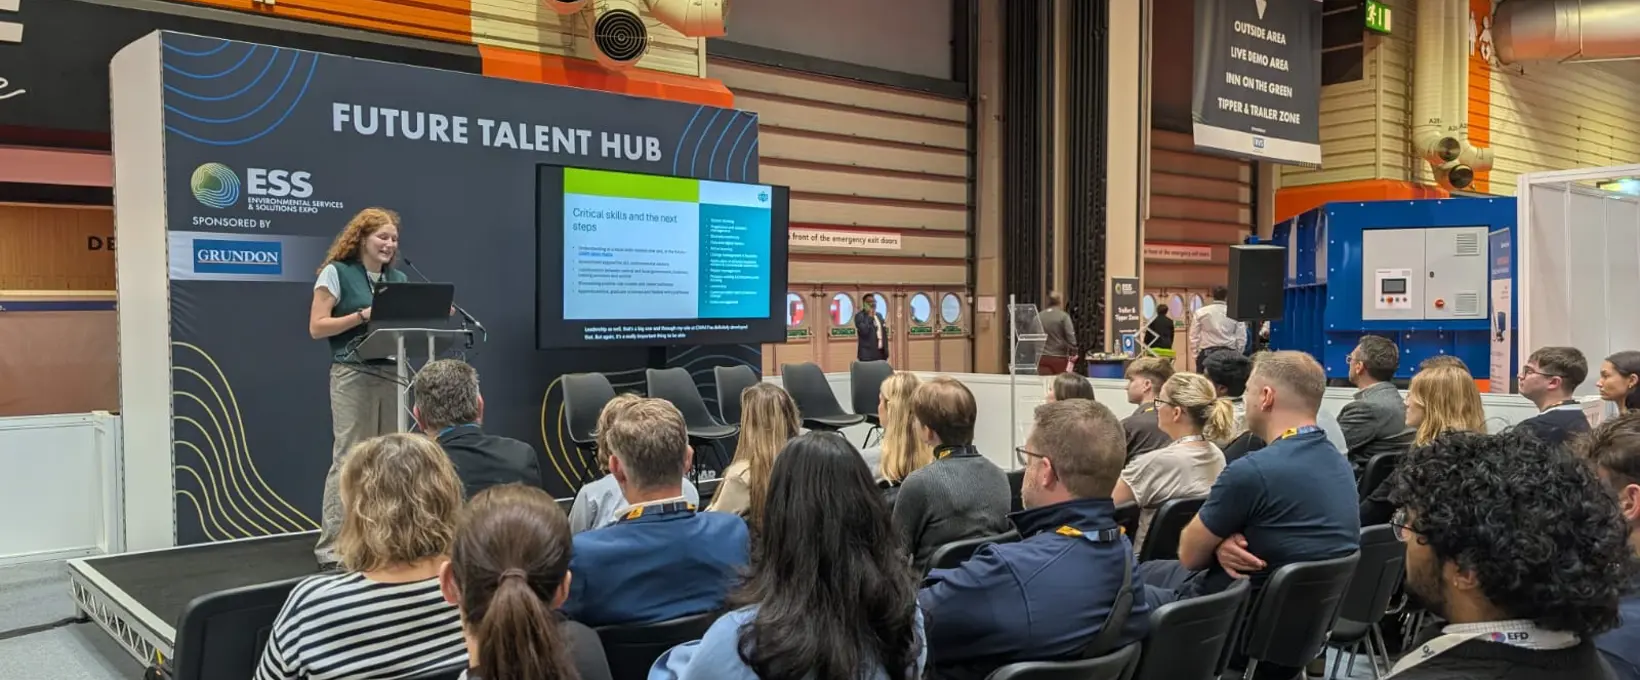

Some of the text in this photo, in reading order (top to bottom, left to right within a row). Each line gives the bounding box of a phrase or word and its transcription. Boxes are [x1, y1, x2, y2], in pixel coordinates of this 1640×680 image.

[1234, 20, 1286, 45] OUTSIDE AREA
[1230, 46, 1289, 72] LIVE DEMO AREA
[1226, 72, 1293, 98] INN ON THE GREEN
[1217, 97, 1300, 125] TIPPER & TRAILER ZONE
[332, 102, 662, 162] FUTURE TALENT HUB
[247, 168, 314, 198] ESS
[248, 196, 344, 208] ENVIRONMENTAL SERVICES
[256, 204, 297, 212] SOLUTIONS
[192, 216, 272, 228] SPONSORED BY
[572, 208, 678, 223] Critical skills and the next
[572, 222, 597, 232] steps
[792, 232, 809, 241] front
[819, 234, 830, 242] the
[832, 236, 866, 245] emergency
[880, 236, 898, 245] doors
[198, 249, 278, 262] GRUNDON
[1508, 632, 1528, 640] EFD
